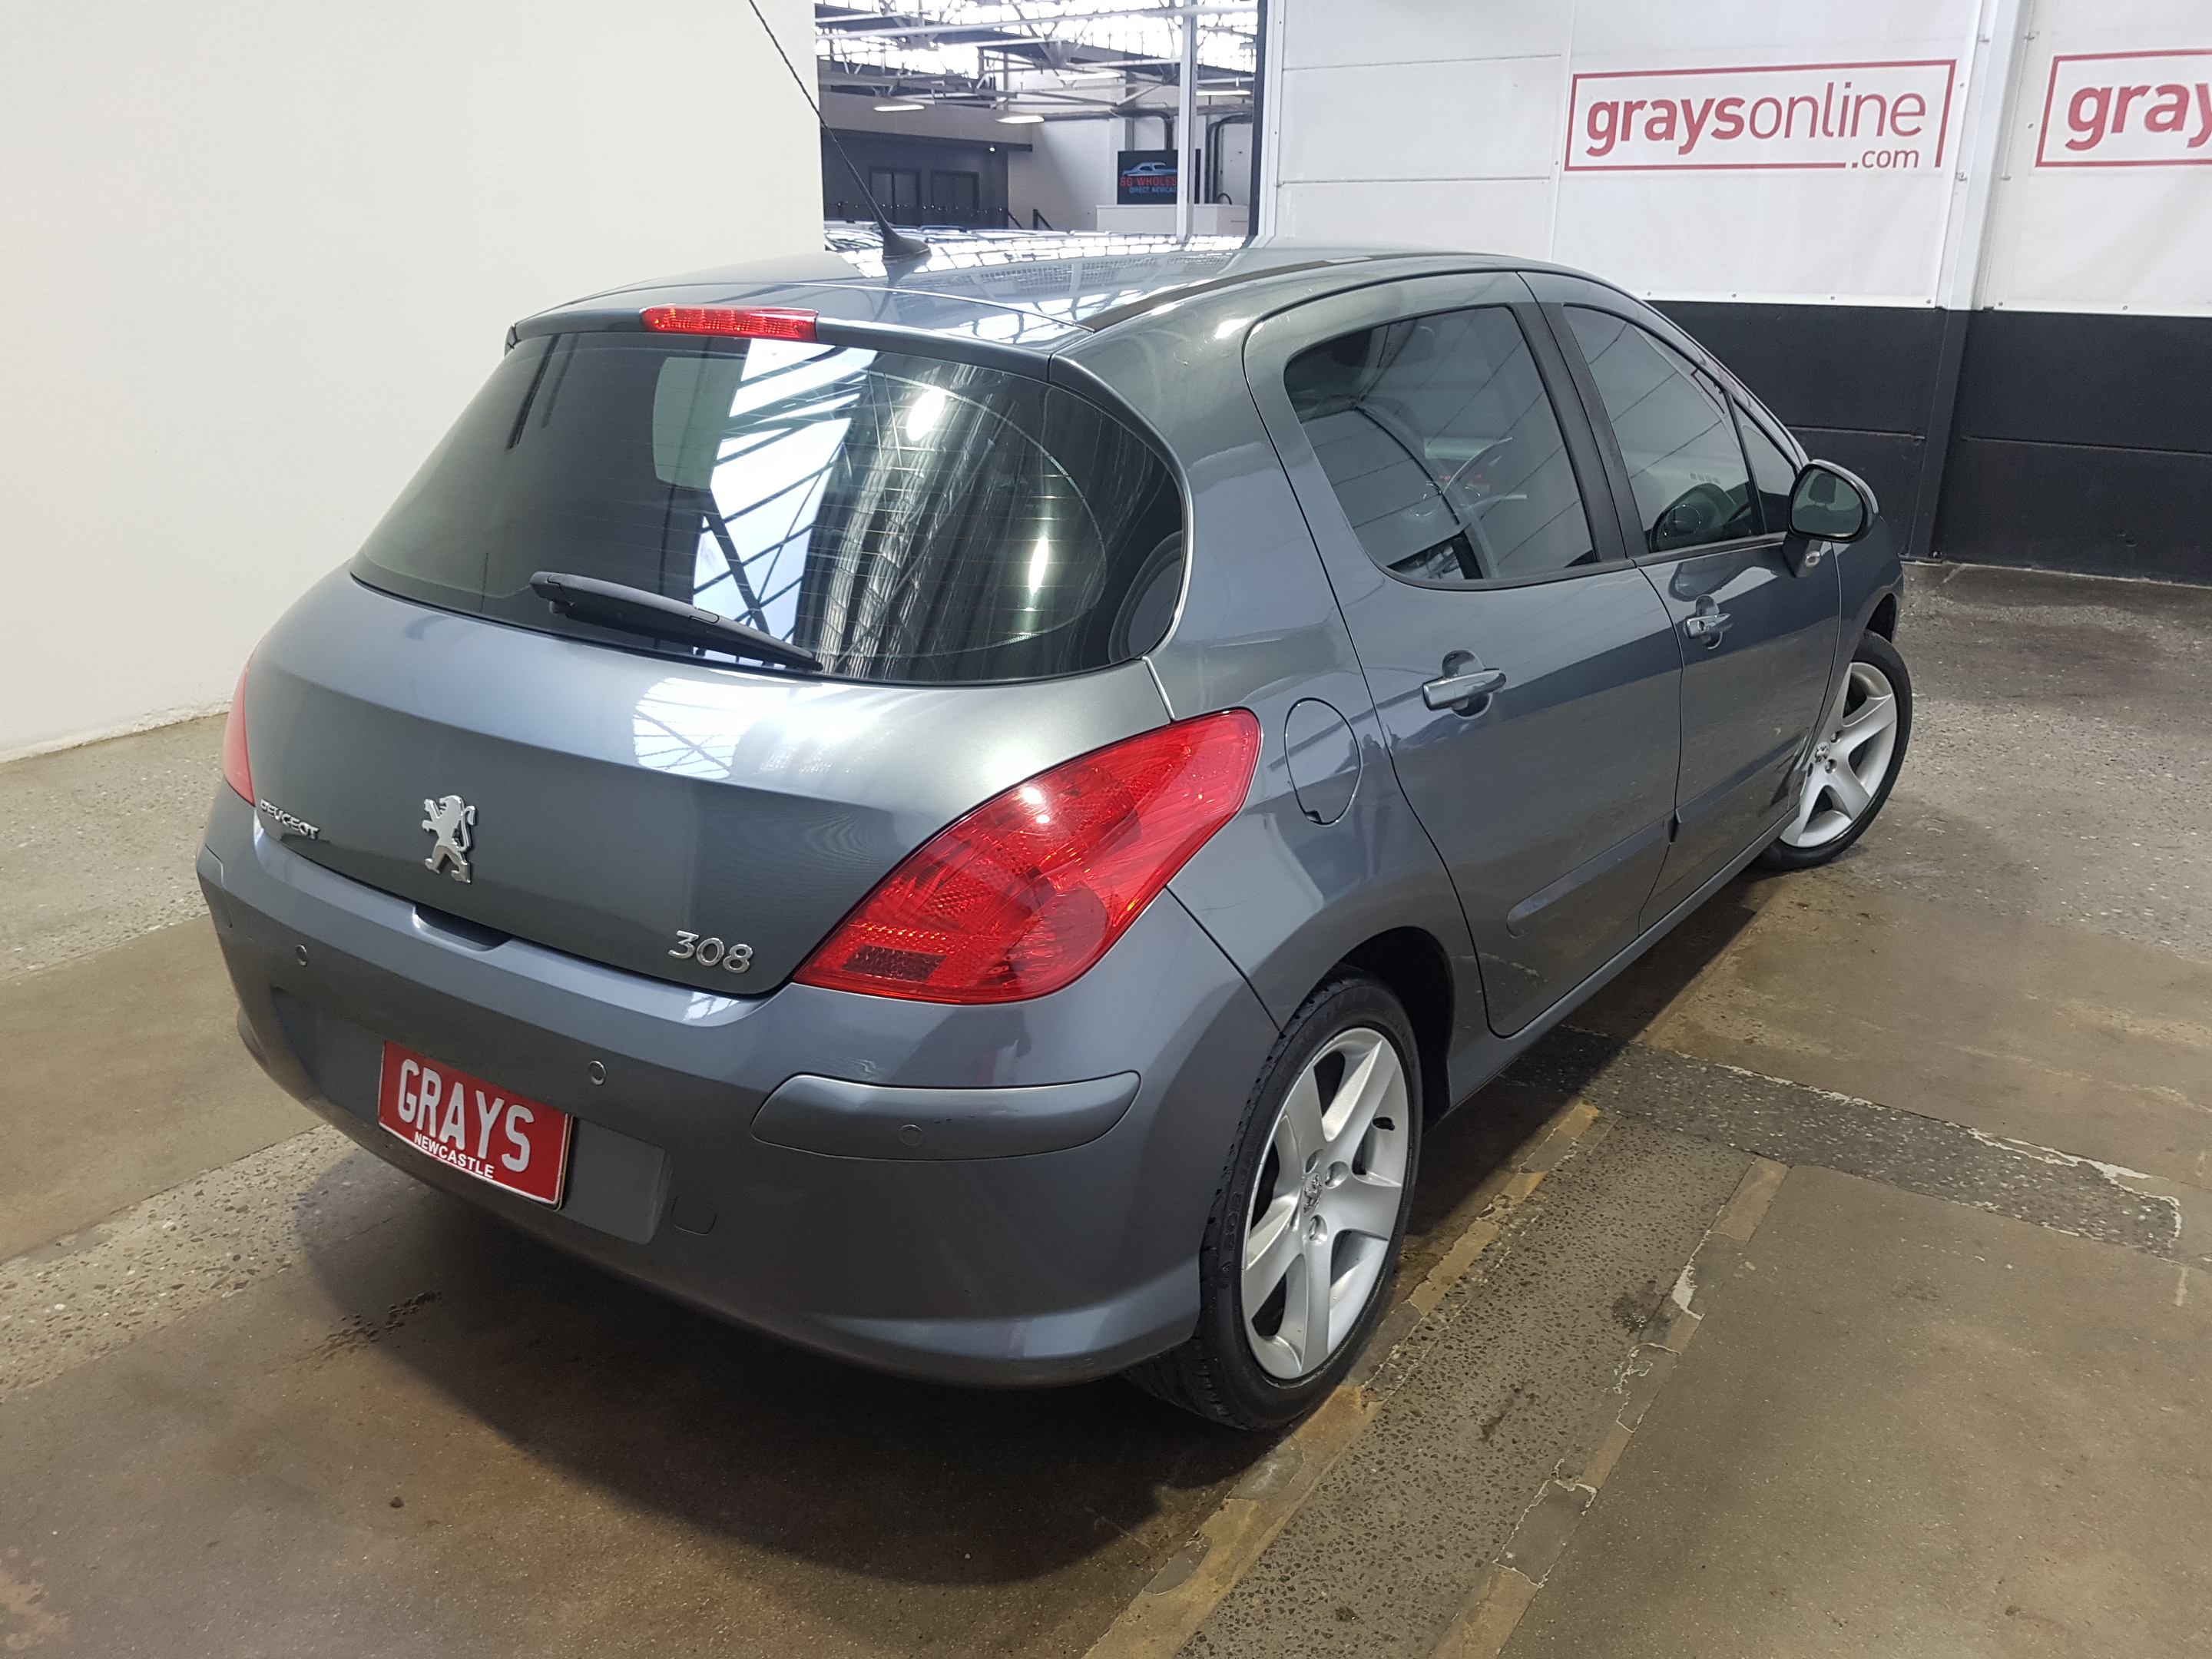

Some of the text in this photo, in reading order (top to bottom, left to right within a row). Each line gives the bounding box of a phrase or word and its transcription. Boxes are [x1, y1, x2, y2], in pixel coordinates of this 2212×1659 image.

[1586, 81, 1926, 157] graysonline
[1852, 150, 1919, 169] .com
[260, 799, 320, 839] PEUGEOT
[667, 930, 753, 974] 308
[397, 1058, 535, 1173] GRAYS
[414, 1131, 495, 1179] NEWCASTLE
